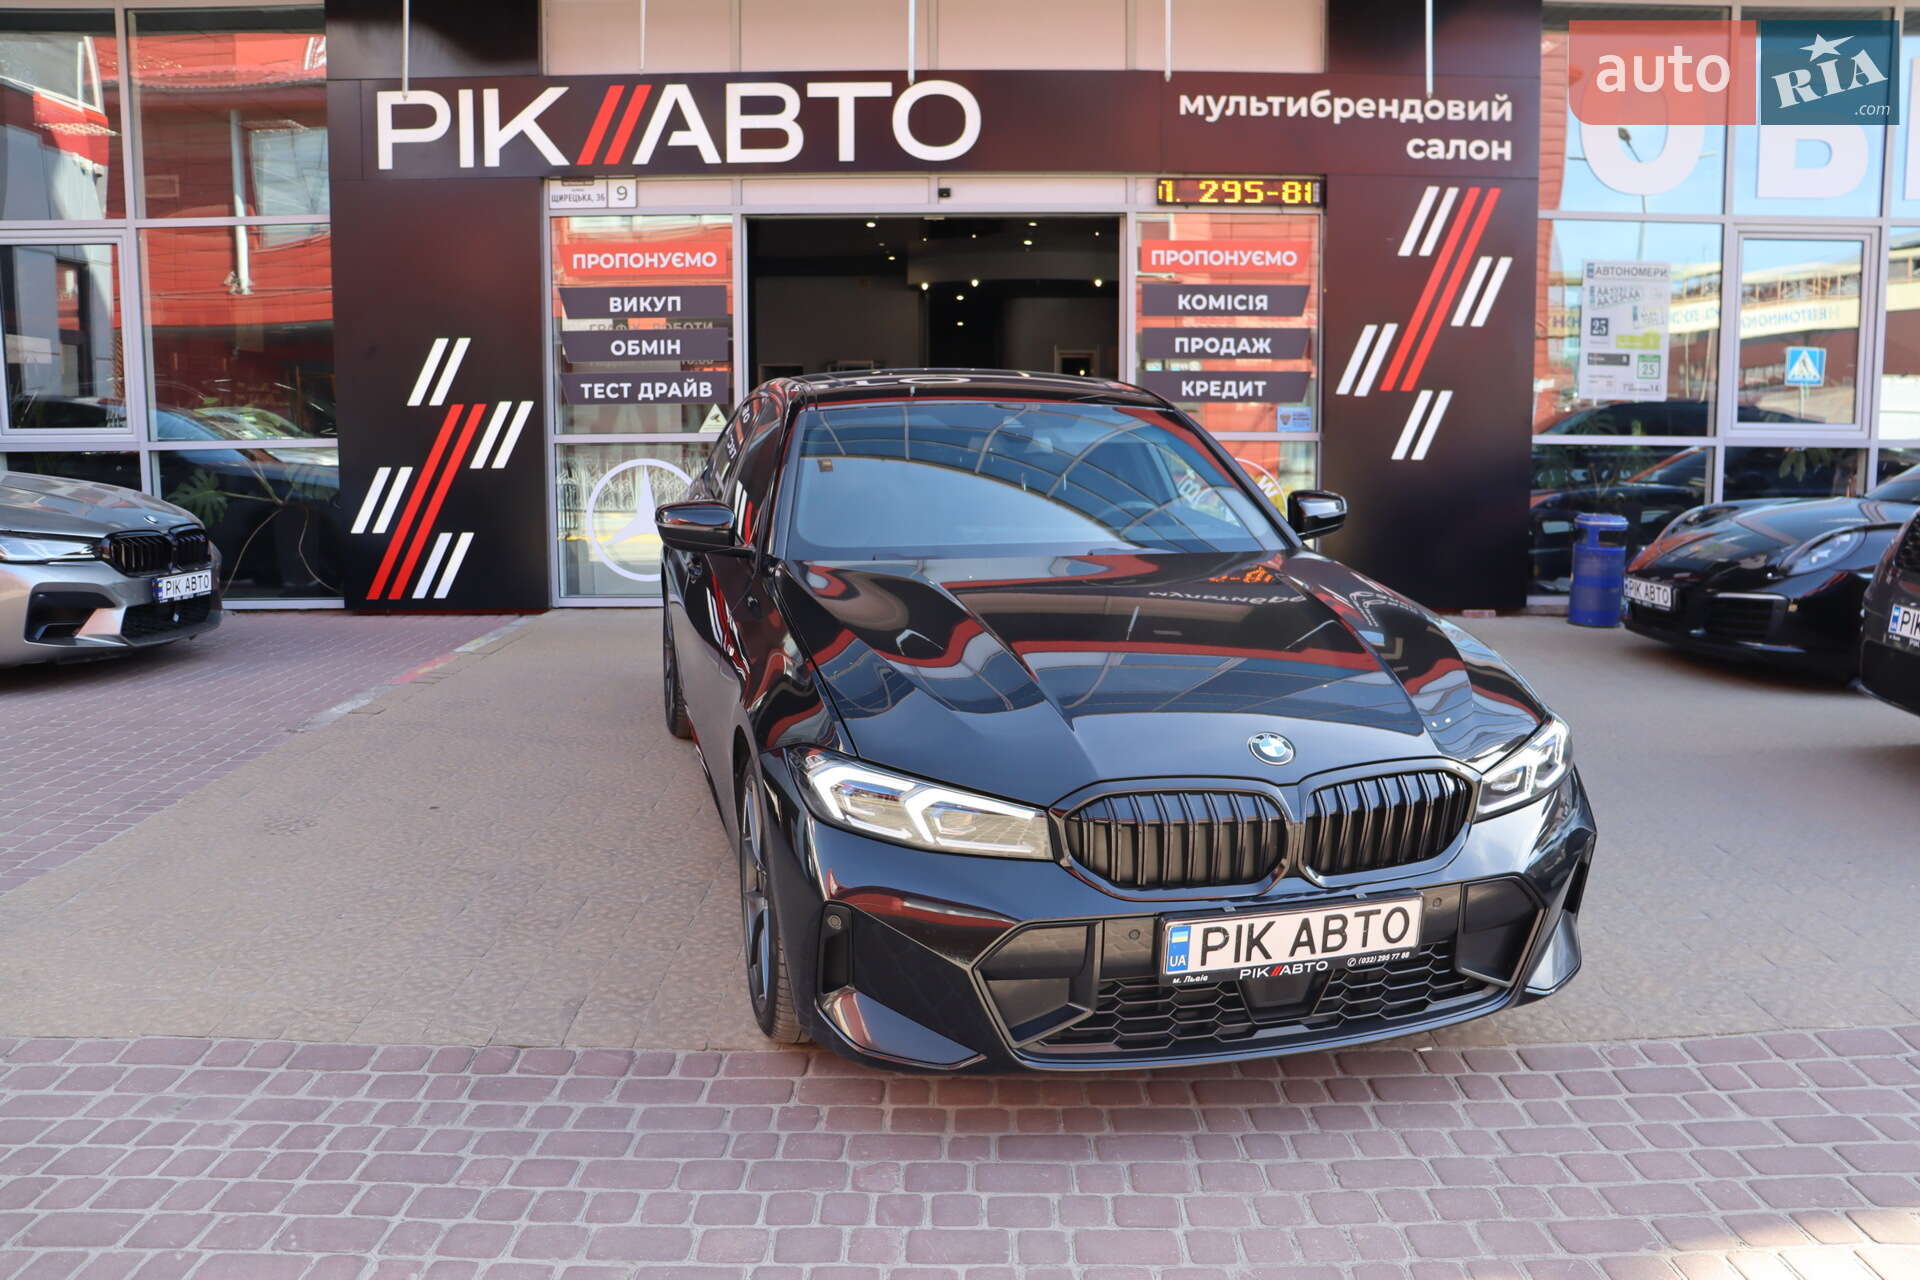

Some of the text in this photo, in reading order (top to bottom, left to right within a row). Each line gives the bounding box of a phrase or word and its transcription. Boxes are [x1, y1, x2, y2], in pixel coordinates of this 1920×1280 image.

[1179, 89, 1512, 124] мультибрендовий
[631, 80, 982, 165] АВТО
[1406, 137, 1512, 160] салон
[616, 185, 628, 201] 9
[573, 252, 717, 269] ПРОПОНУЄМО
[1151, 249, 1298, 266] ПРОПОНУЄМО
[1596, 266, 1668, 278] АВТОНОМЕРИ
[609, 296, 681, 312] ВИКУП
[1178, 294, 1268, 311] КОМІСІЯ
[1592, 318, 1607, 335] 25
[610, 339, 681, 356] ОБМІН
[1174, 337, 1272, 356] ПРОДАЖ
[1642, 364, 1655, 376] 25
[580, 378, 713, 401] ТЕСТ ДРАЙВ
[1181, 380, 1267, 399] КРЕДИТ
[1200, 906, 1410, 967] РІК АВТО
[1170, 954, 1186, 967] UA
